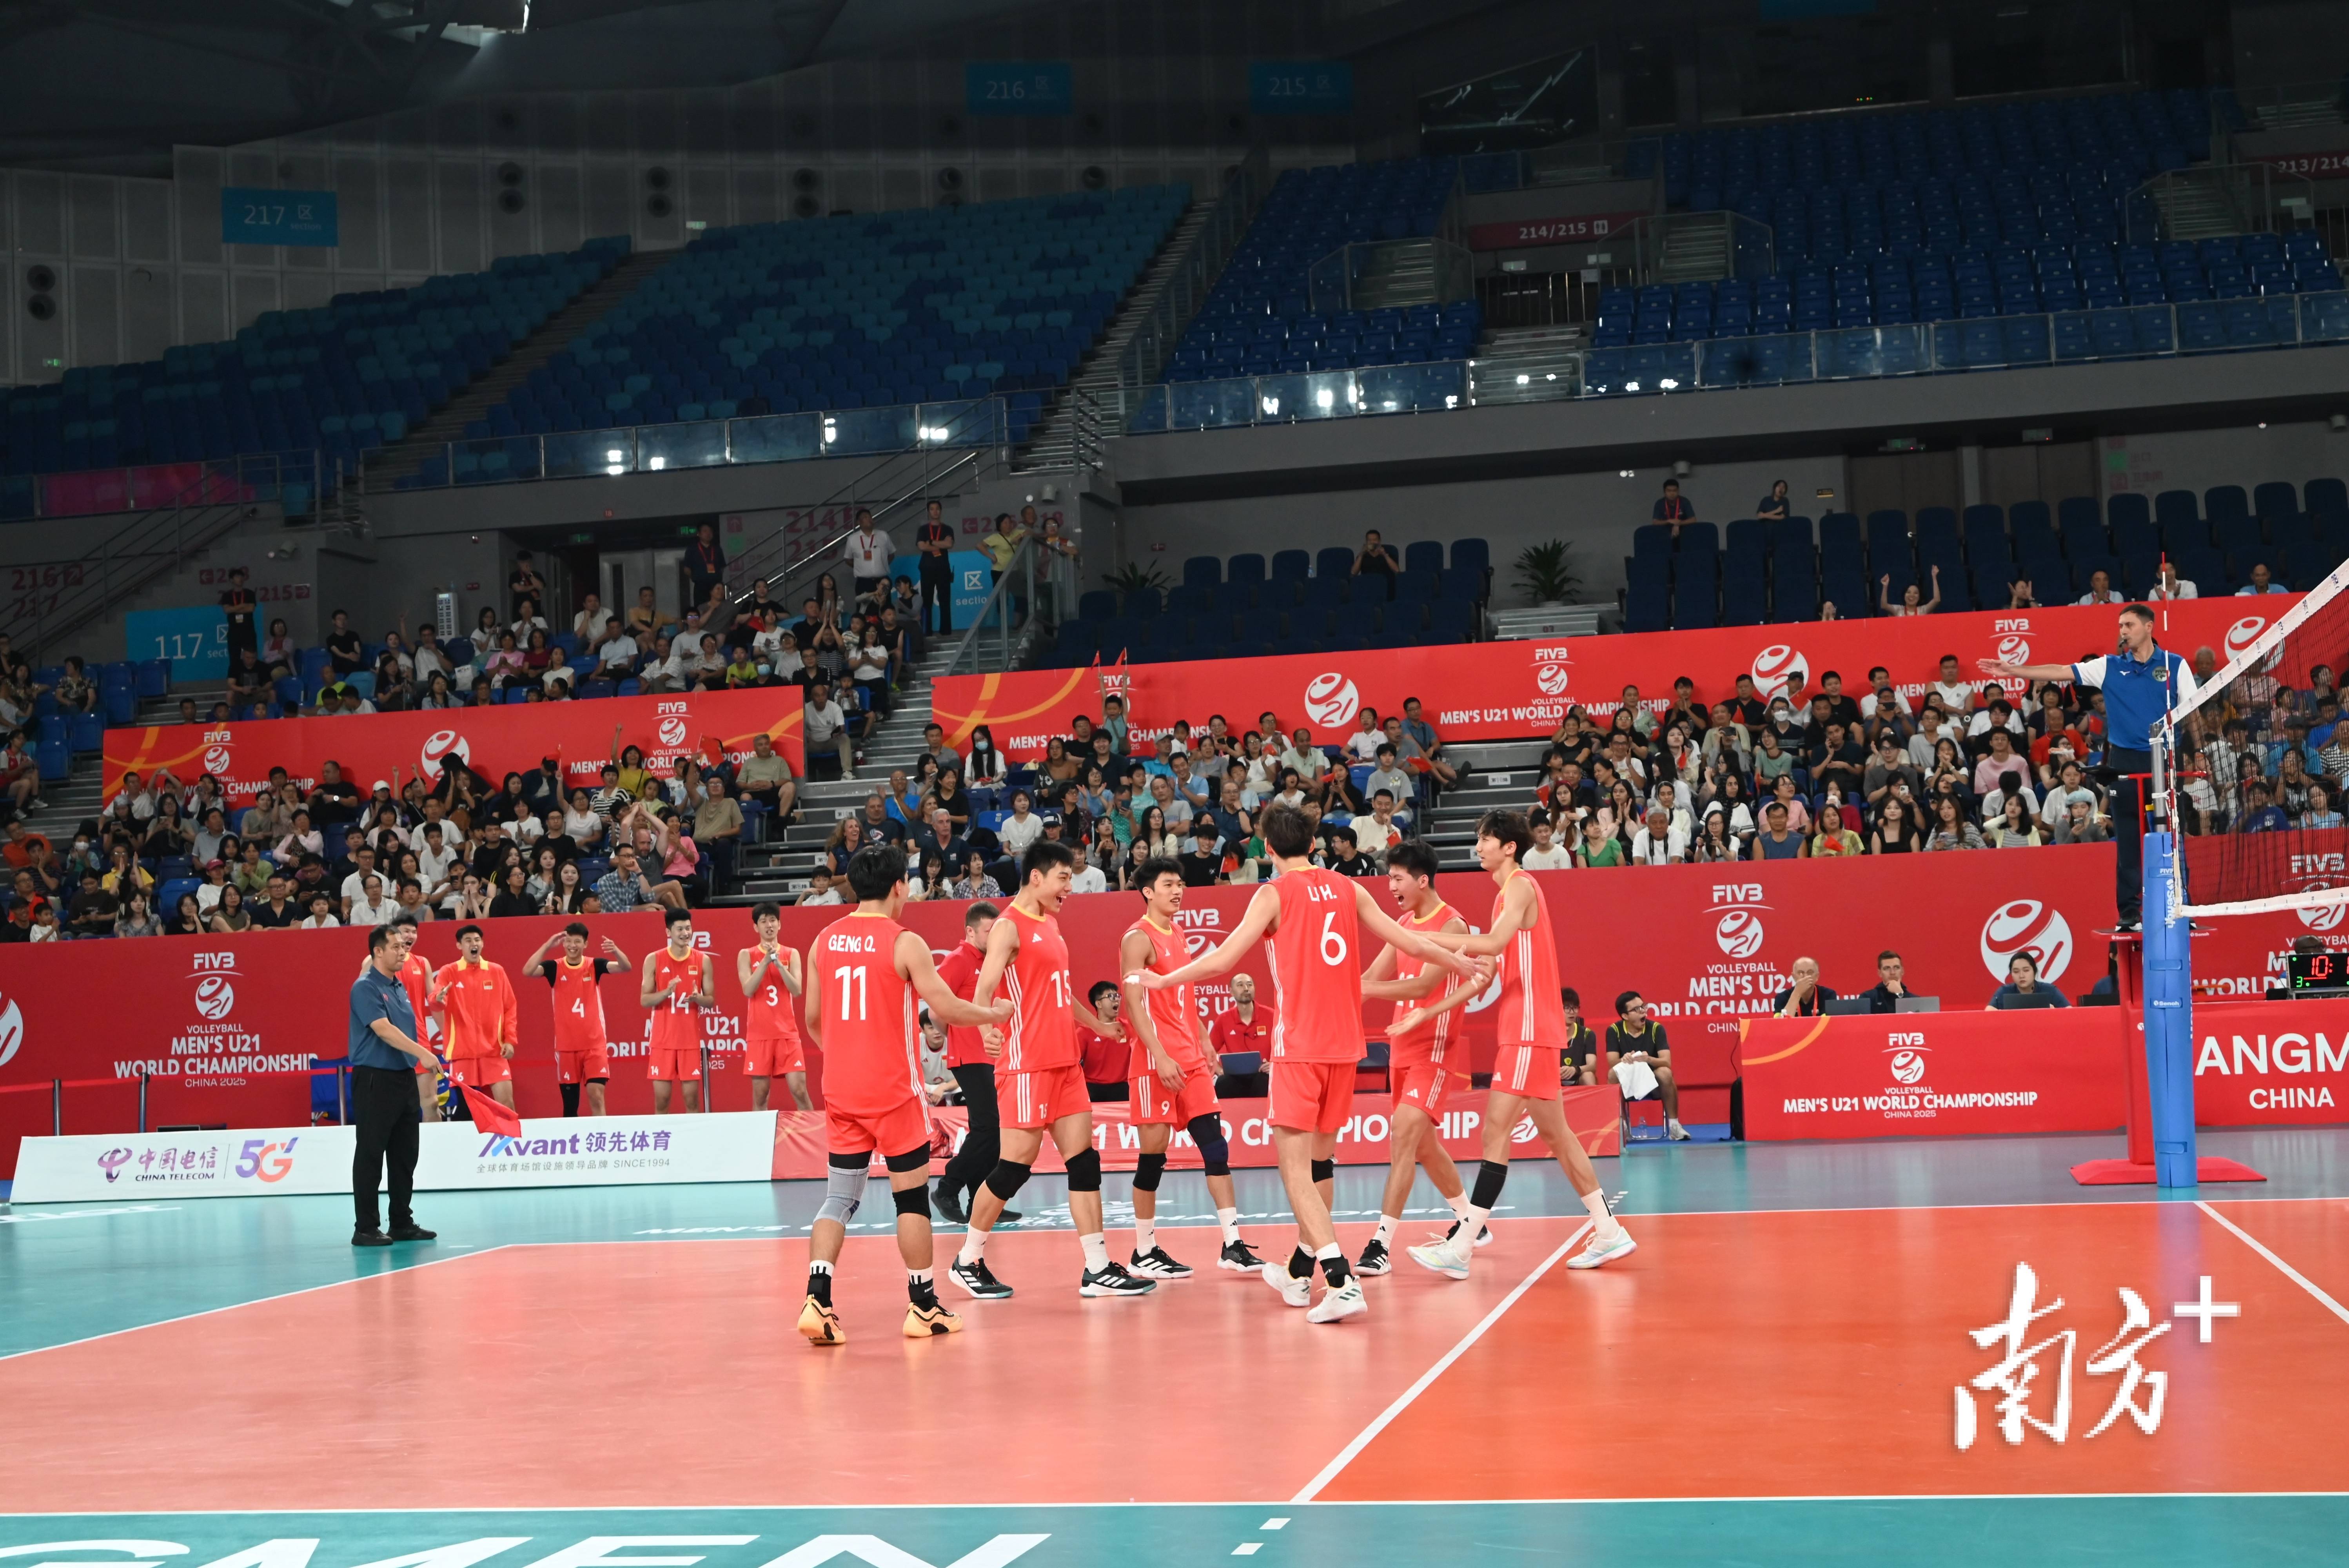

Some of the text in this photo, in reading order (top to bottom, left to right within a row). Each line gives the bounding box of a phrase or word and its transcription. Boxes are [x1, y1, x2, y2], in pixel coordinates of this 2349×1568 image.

[986, 80, 1025, 99] 216
[1269, 77, 1306, 96] 215
[244, 205, 285, 225] 217
[1519, 222, 1587, 239] 214/215
[12, 566, 58, 591] 216
[955, 596, 988, 606] sectio
[1995, 618, 2029, 632] FIVB
[155, 633, 203, 660] 117
[1535, 647, 1568, 660] FIVB
[658, 702, 687, 714] FIVB
[1484, 708, 1508, 722] U21
[1513, 704, 1563, 720] WORLD
[1531, 719, 1555, 728] CHINA
[203, 731, 231, 742] FIVB
[653, 748, 692, 756] VOLLEYBALL
[2291, 852, 2345, 874] FIVB
[1713, 883, 1763, 903] FIVB
[828, 935, 876, 953] GENG Q.
[1320, 911, 1347, 966] 6
[194, 952, 235, 969] FIVB
[1706, 962, 1777, 974] VOLLEYBALL
[1051, 970, 1072, 1008] 15
[2296, 976, 2303, 988] 3
[765, 985, 778, 1007] 3
[835, 965, 866, 1020] 11
[1177, 984, 1185, 1019] 9
[571, 998, 585, 1018] 4
[668, 991, 689, 1014] 14
[187, 1024, 244, 1034] VOLLEYBALL
[706, 1016, 739, 1035] U21
[229, 1034, 260, 1052] U21
[1888, 1032, 1925, 1046] FIVB
[114, 1057, 180, 1079] WORLD
[650, 1065, 659, 1076] 14
[748, 1061, 753, 1071] 3
[185, 1078, 217, 1088] CHINA
[563, 1071, 570, 1080] 4
[1884, 1086, 1934, 1095] VOLLEYBALL
[2249, 1087, 2335, 1110] CHINA
[1160, 1100, 1170, 1116] 9
[1832, 1097, 1859, 1112] U21
[1864, 1095, 1920, 1111] WORLD
[1923, 1091, 2038, 1109] CHAMPIONSHIP
[1038, 1103, 1048, 1120] 15
[1884, 1109, 1937, 1119] CHINA 2025
[586, 1129, 672, 1153] 领先体育
[138, 1146, 219, 1171] 中国电信
[235, 1137, 299, 1183] 5G
[476, 1158, 670, 1174] 全球体育场馆设施领导品牌 SINCE1994
[135, 1172, 214, 1182] CHINA TELECOM
